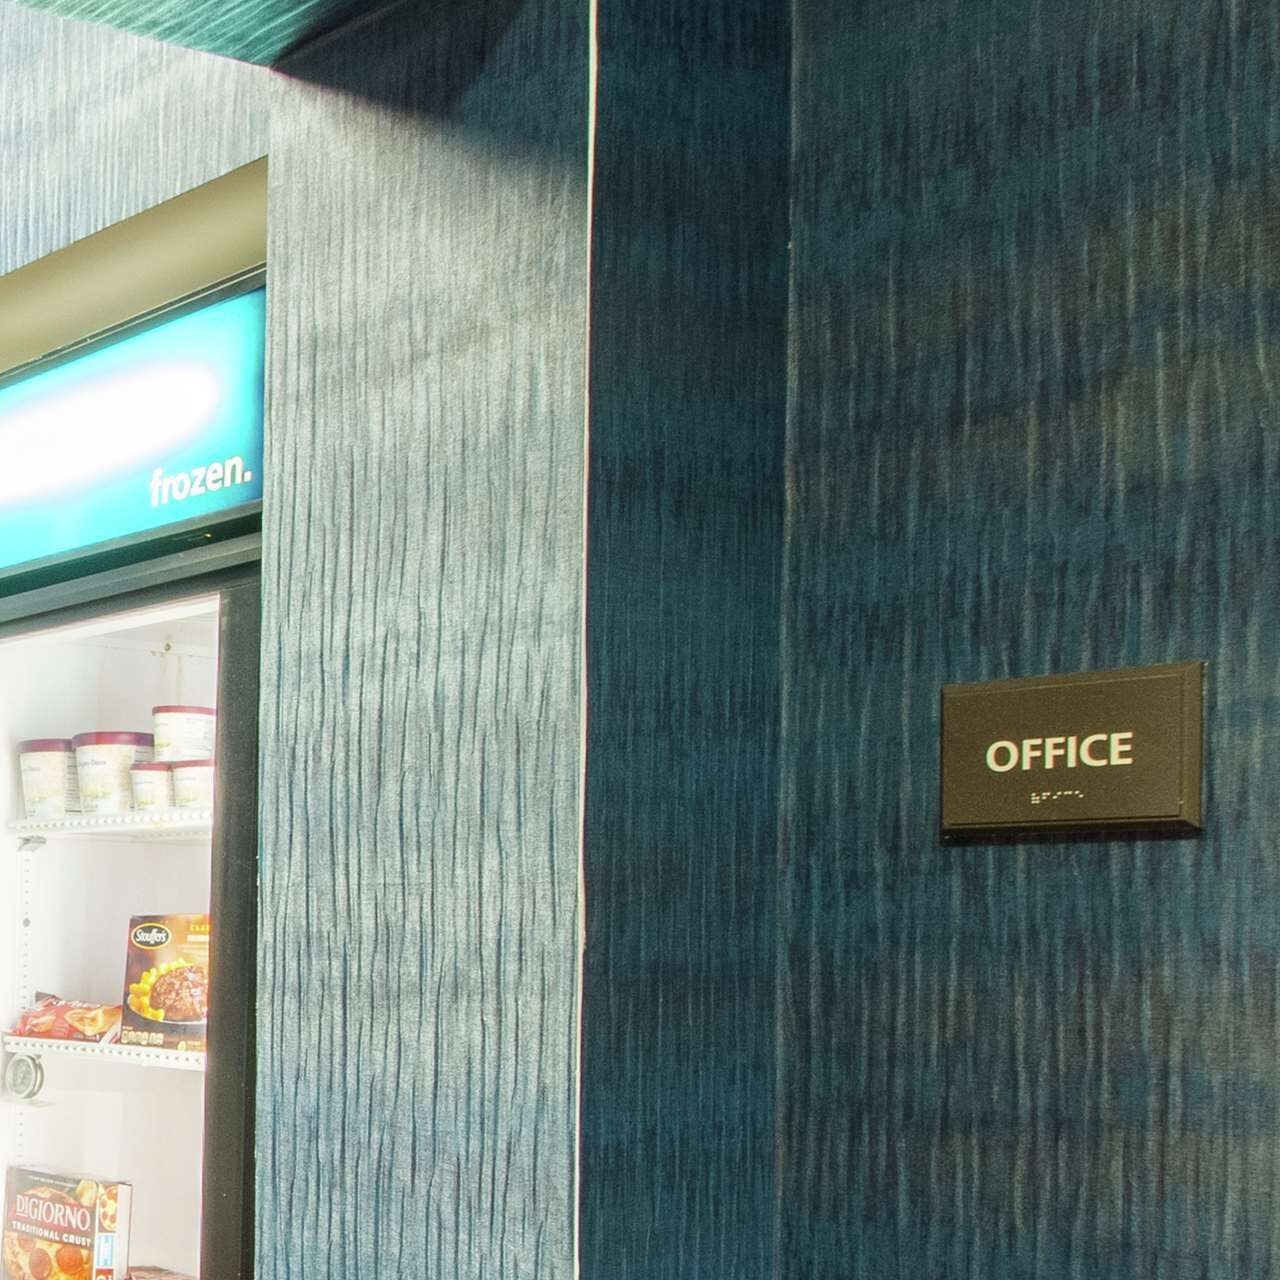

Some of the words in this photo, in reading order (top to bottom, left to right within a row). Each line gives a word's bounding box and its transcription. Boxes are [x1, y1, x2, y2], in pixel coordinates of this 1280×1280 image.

[149, 455, 252, 508] frozen.
[986, 731, 1134, 773] OFFICE
[15, 1194, 91, 1232] DIGIORNO
[12, 1221, 60, 1241] TRADITIONAL
[62, 1233, 92, 1247] CRUST
